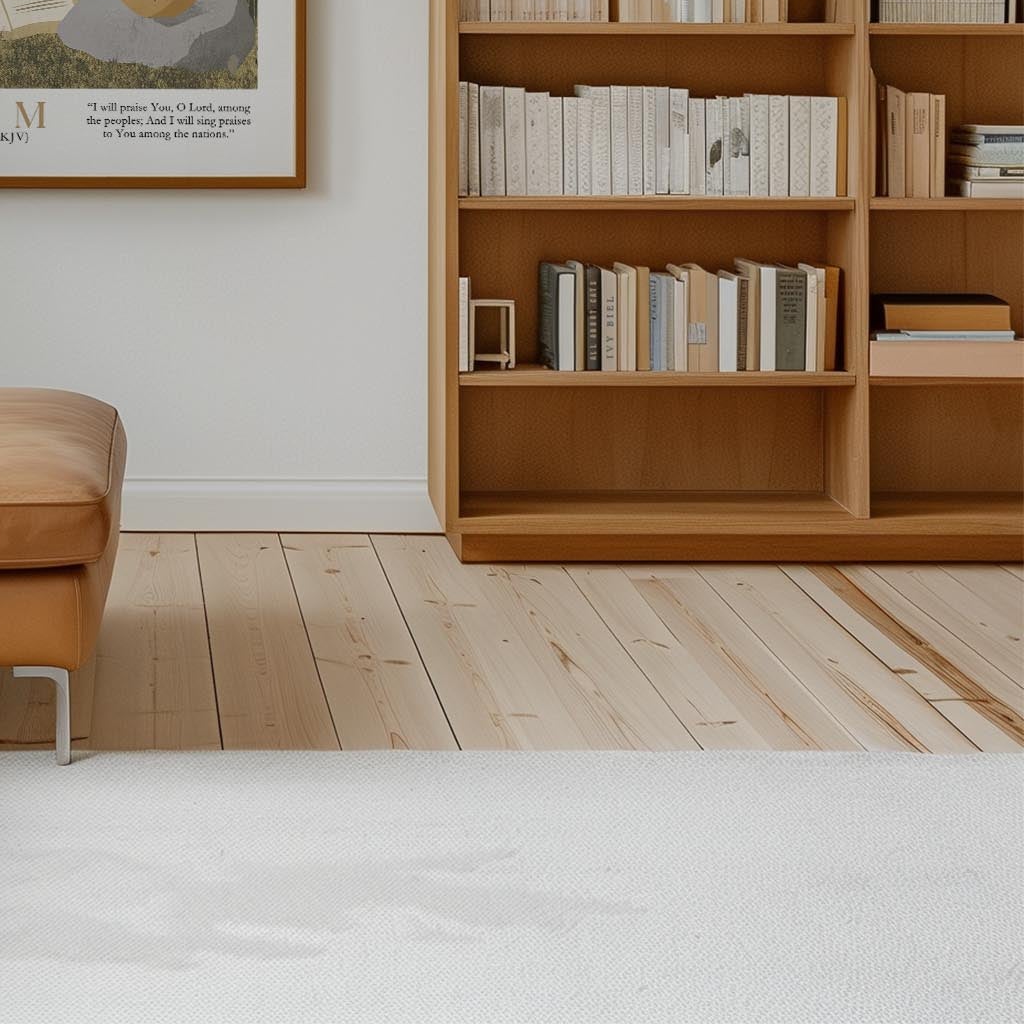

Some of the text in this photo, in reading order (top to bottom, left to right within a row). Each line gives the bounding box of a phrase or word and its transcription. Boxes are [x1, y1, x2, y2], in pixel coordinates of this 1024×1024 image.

[100, 102, 117, 112] will
[120, 102, 148, 114] praise
[151, 102, 174, 114] You,
[176, 102, 186, 112] O
[189, 102, 216, 114] Lord,
[218, 105, 251, 115] among
[86, 115, 252, 128] the peoples; And I will sing praises
[103, 129, 113, 139] to
[115, 129, 137, 139] You
[138, 129, 172, 141] among
[174, 129, 190, 139] the
[607, 296, 615, 359] IVY BIEL
[589, 343, 597, 361] ALL
